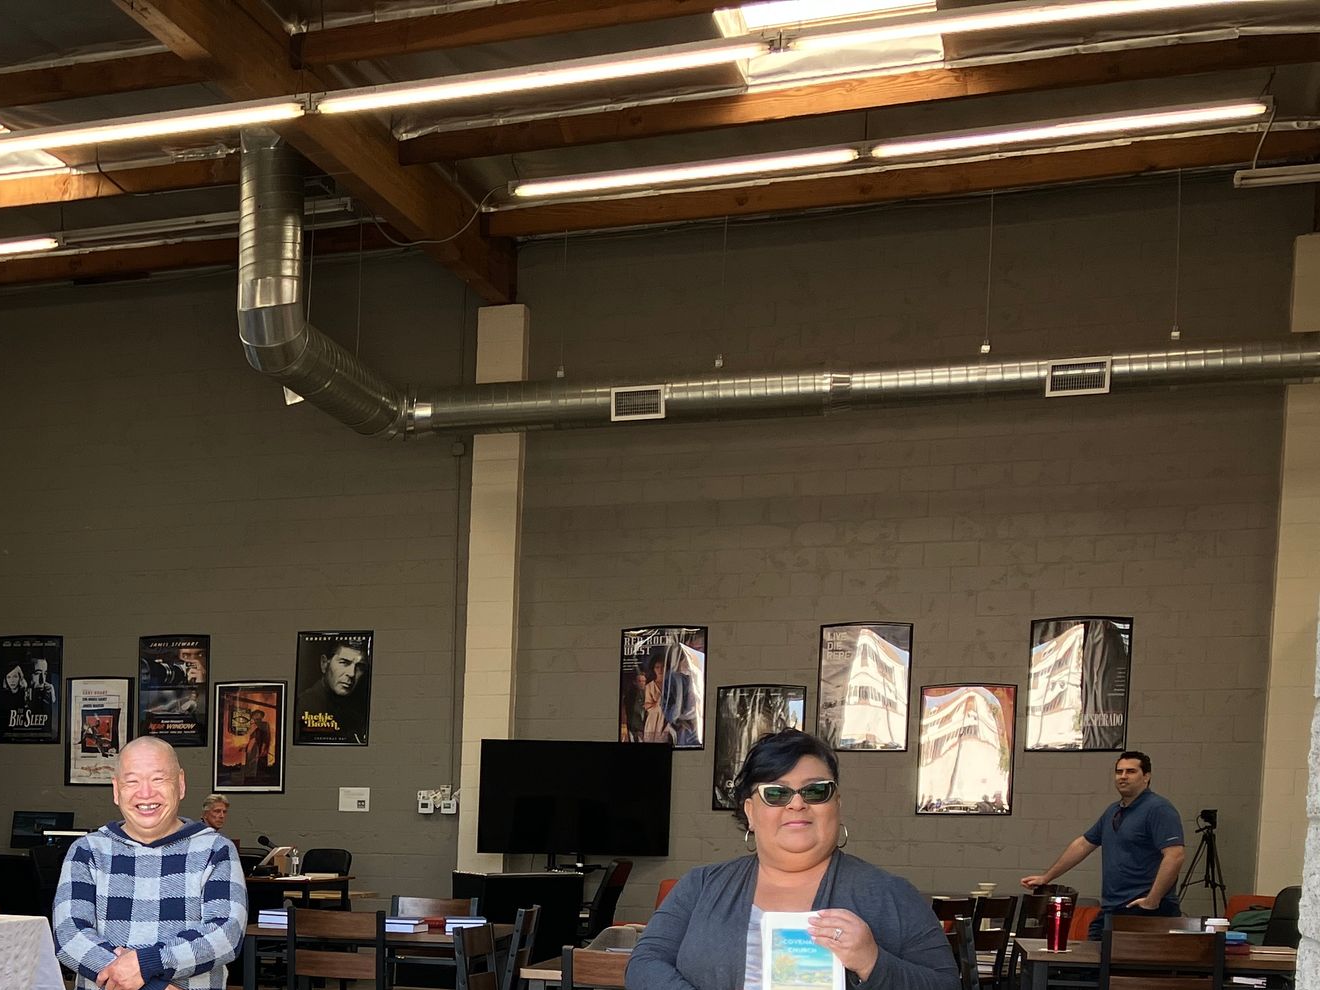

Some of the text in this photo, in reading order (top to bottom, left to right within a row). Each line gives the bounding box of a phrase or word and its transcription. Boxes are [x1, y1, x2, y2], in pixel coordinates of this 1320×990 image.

[827, 641, 843, 651] DIE
[826, 650, 852, 661] REPE
[24, 709, 48, 728] SLEEP
